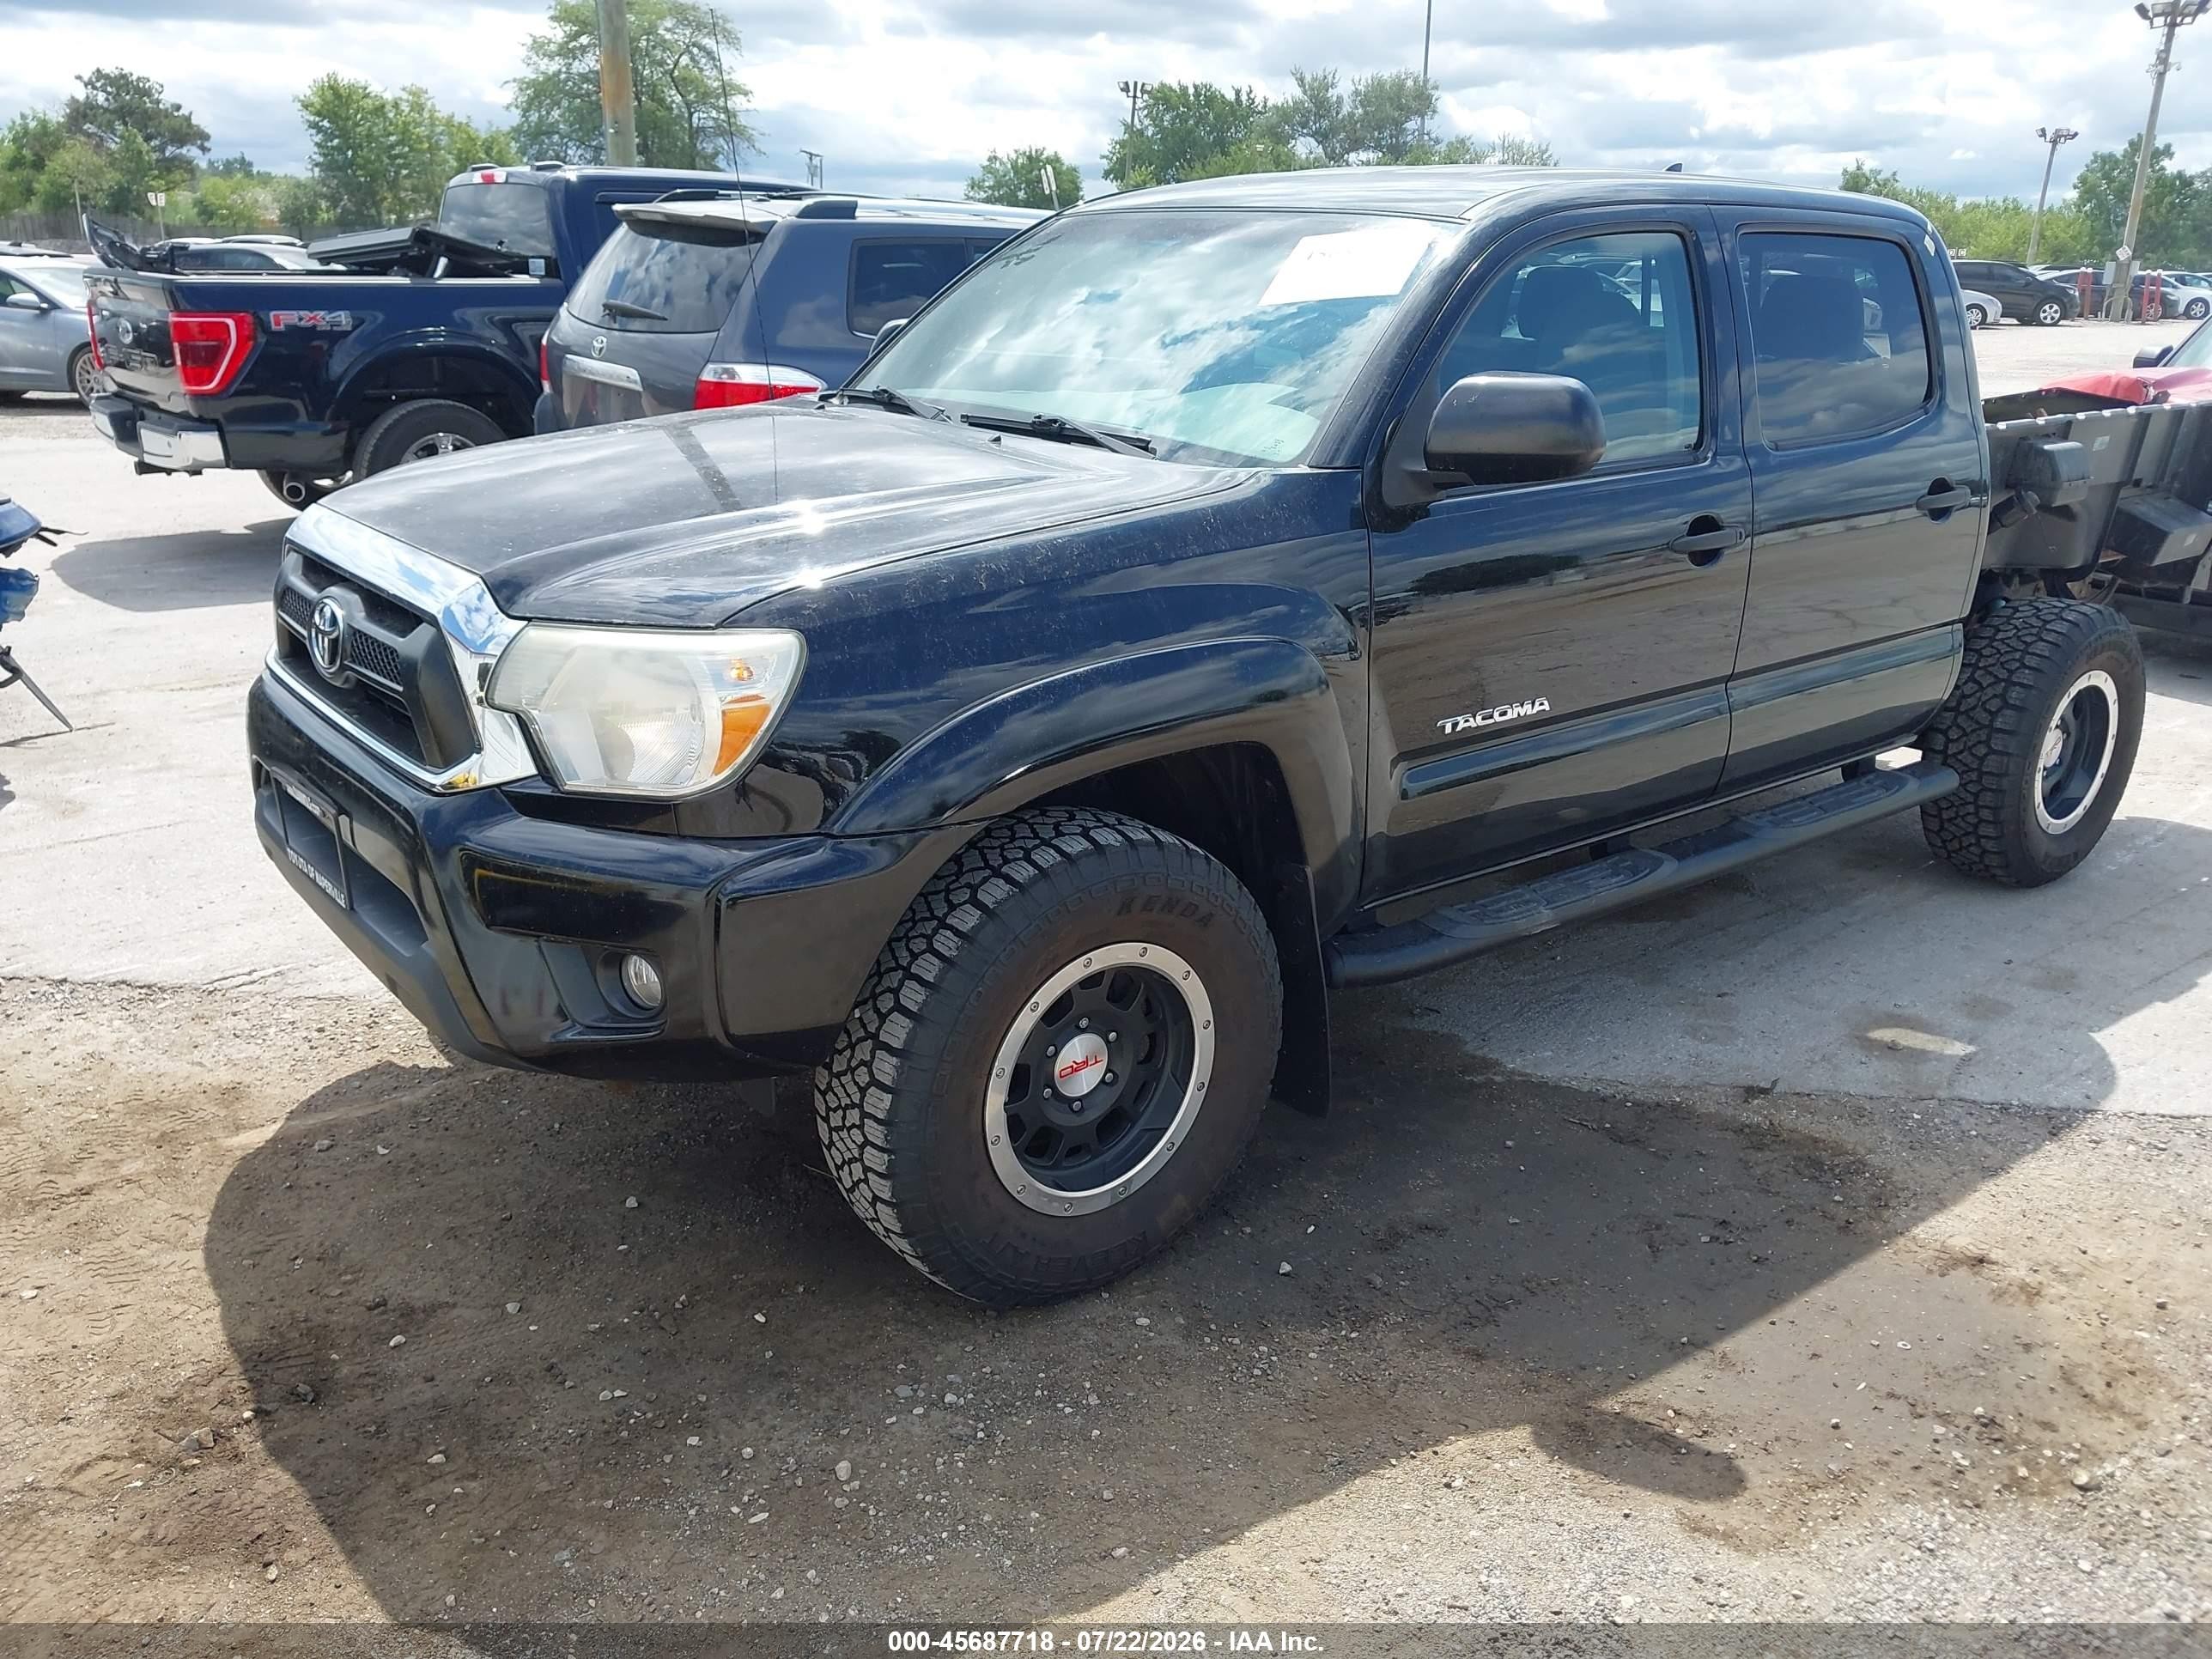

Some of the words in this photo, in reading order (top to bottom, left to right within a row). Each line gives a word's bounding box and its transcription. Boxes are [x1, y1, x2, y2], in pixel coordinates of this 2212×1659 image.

[270, 310, 351, 331] FX4
[1436, 696, 1551, 735] TACOMA
[287, 847, 308, 875] TOYOTA
[307, 863, 315, 880] OF
[1116, 894, 1216, 927] KENDA
[1059, 1054, 1104, 1079] TRD
